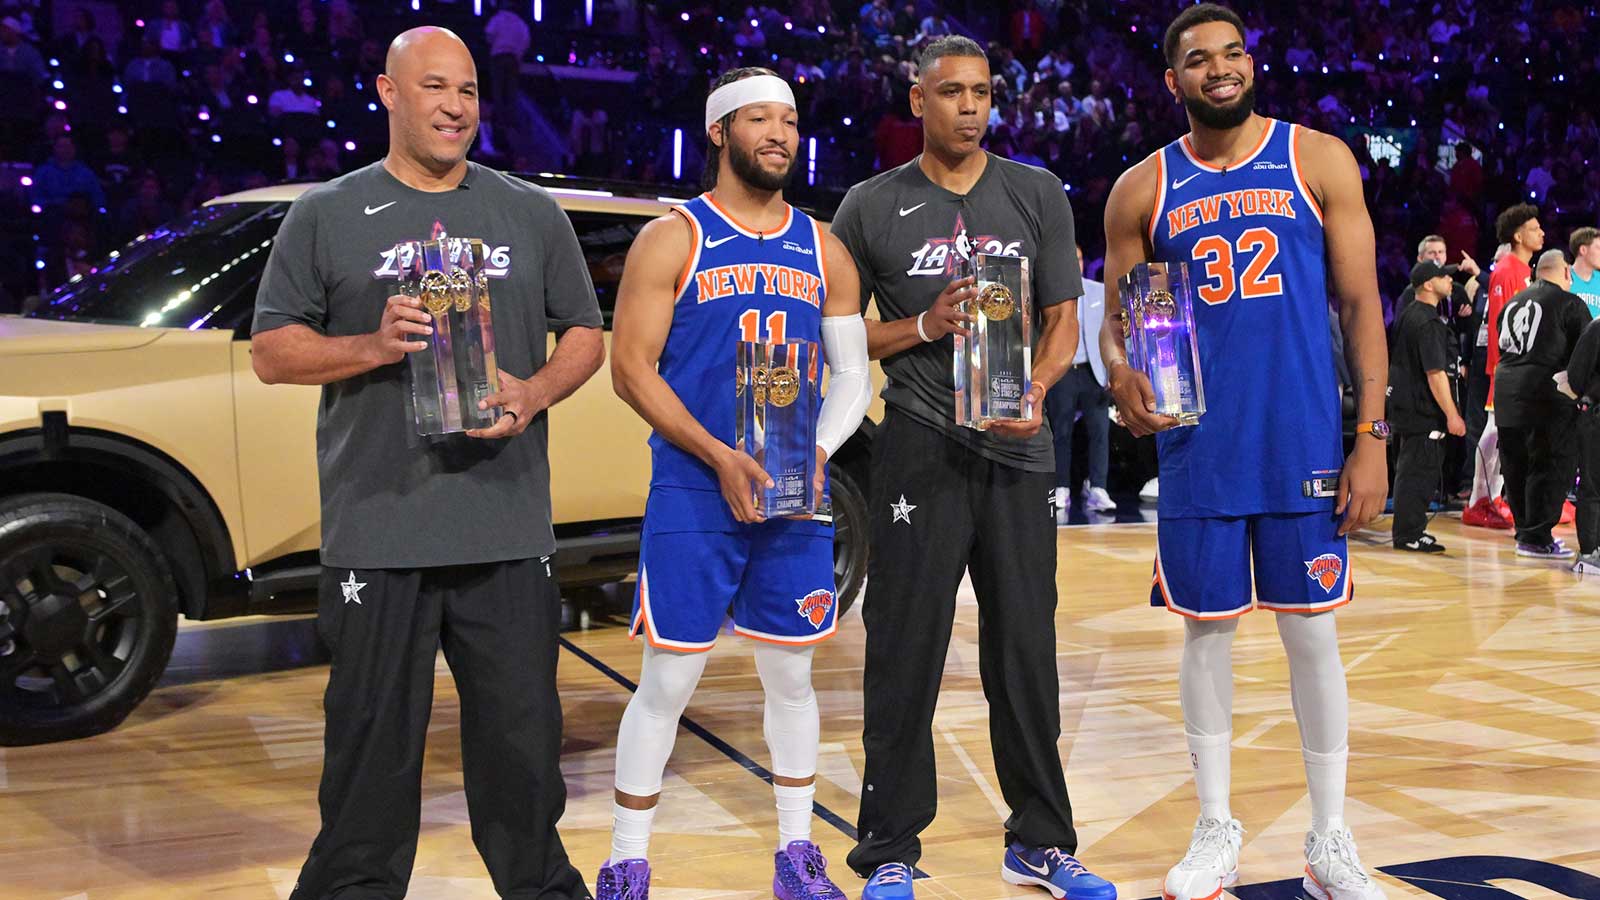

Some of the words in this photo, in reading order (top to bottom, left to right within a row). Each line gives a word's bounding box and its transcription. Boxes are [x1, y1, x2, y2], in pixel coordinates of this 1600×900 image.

[1253, 162, 1267, 170] abu
[1167, 192, 1222, 240] NEW
[1224, 188, 1296, 220] YORK
[906, 242, 949, 277] LA
[1191, 226, 1283, 306] 32
[695, 264, 757, 304] NEW
[759, 263, 821, 310] YORK
[739, 309, 787, 344] 11
